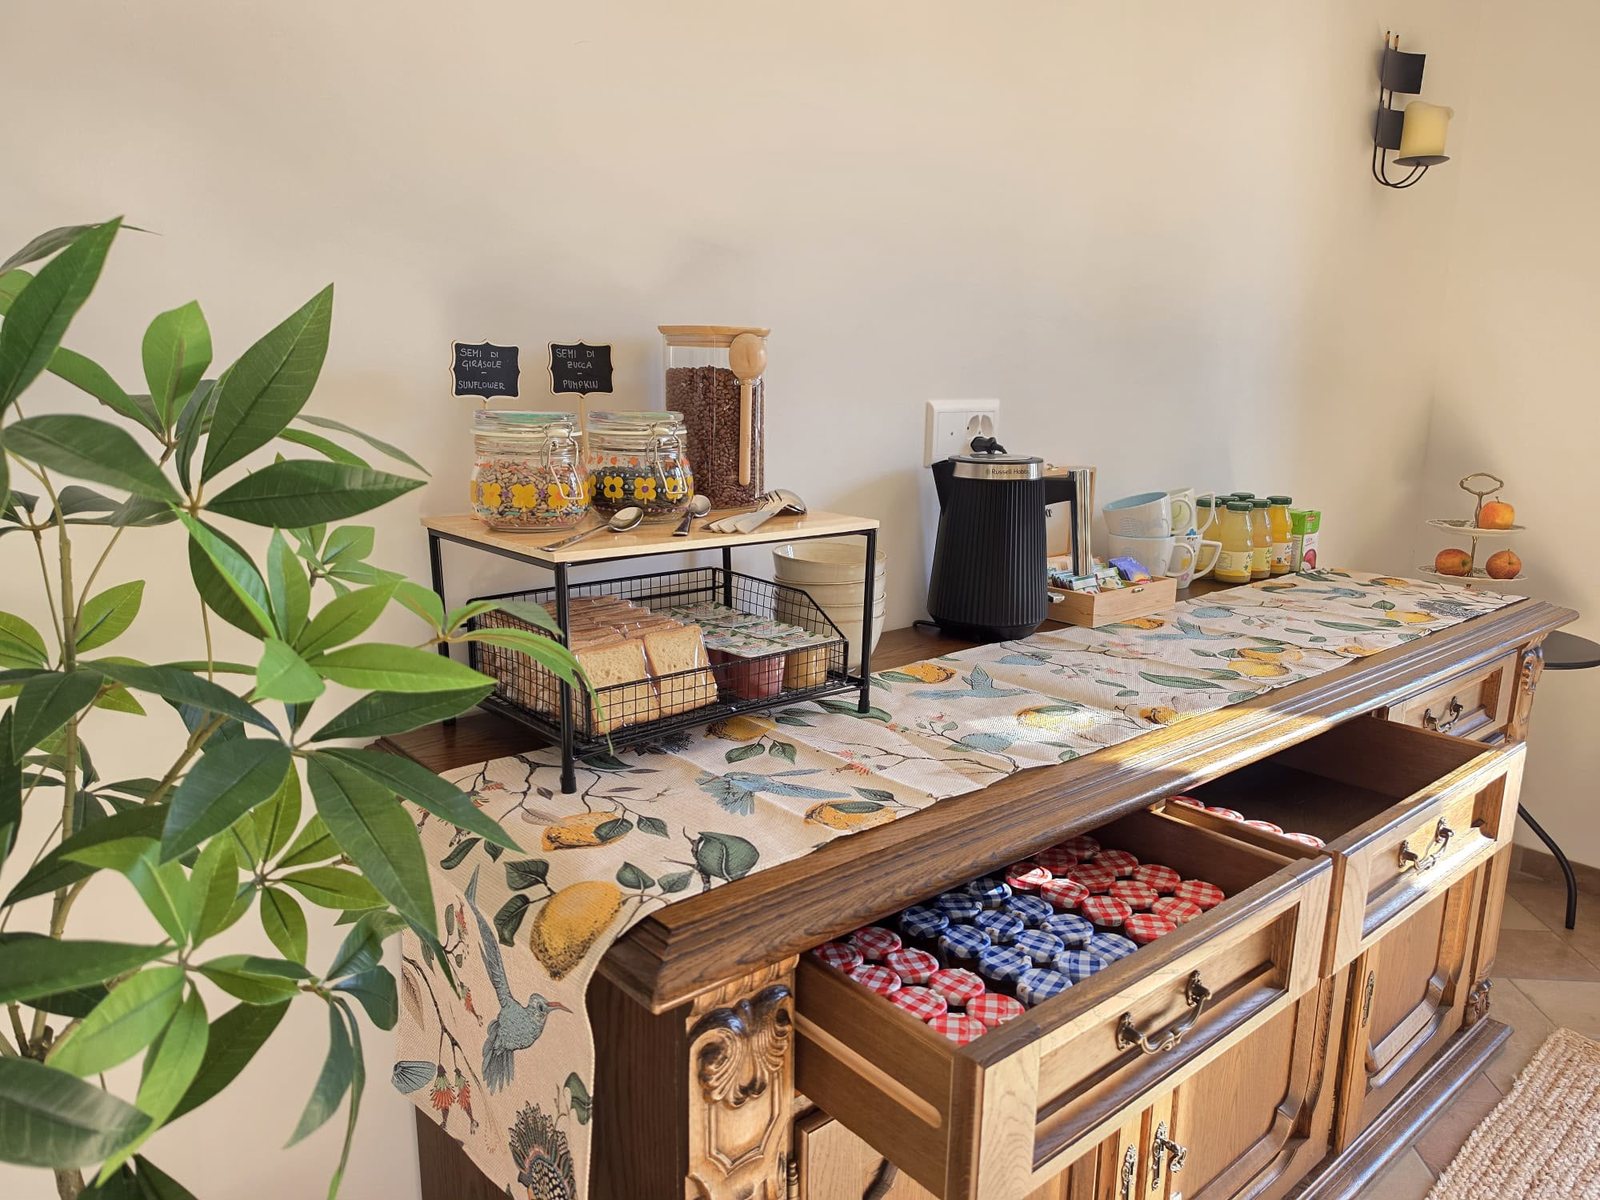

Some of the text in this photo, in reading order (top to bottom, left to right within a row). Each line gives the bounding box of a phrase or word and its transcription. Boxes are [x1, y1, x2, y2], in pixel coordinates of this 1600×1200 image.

[459, 348, 499, 359] SEMI DI
[556, 349, 595, 359] SEMI DI
[461, 360, 502, 371] GIRASOLE
[458, 379, 506, 391] SUNFLOWER
[562, 379, 599, 390] PUMPKIN
